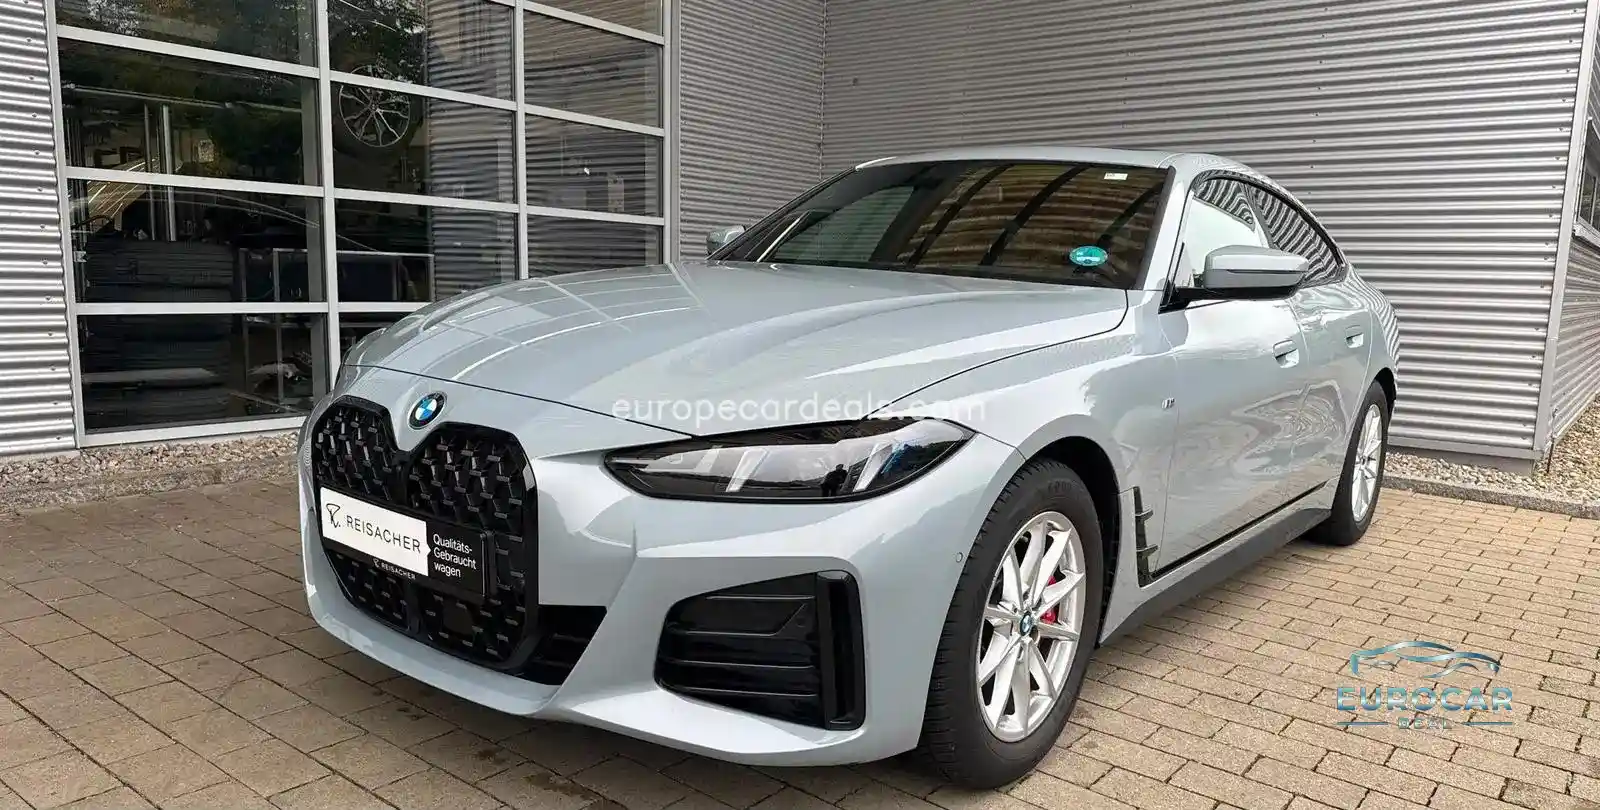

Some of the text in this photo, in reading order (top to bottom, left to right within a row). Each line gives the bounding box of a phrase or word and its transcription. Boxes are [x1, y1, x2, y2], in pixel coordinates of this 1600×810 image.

[346, 515, 421, 554] REISACHER
[433, 533, 473, 554] Qualitäts-
[433, 546, 477, 570] Gebraucht
[381, 562, 416, 580] REISACHER
[433, 561, 461, 578] wagen
